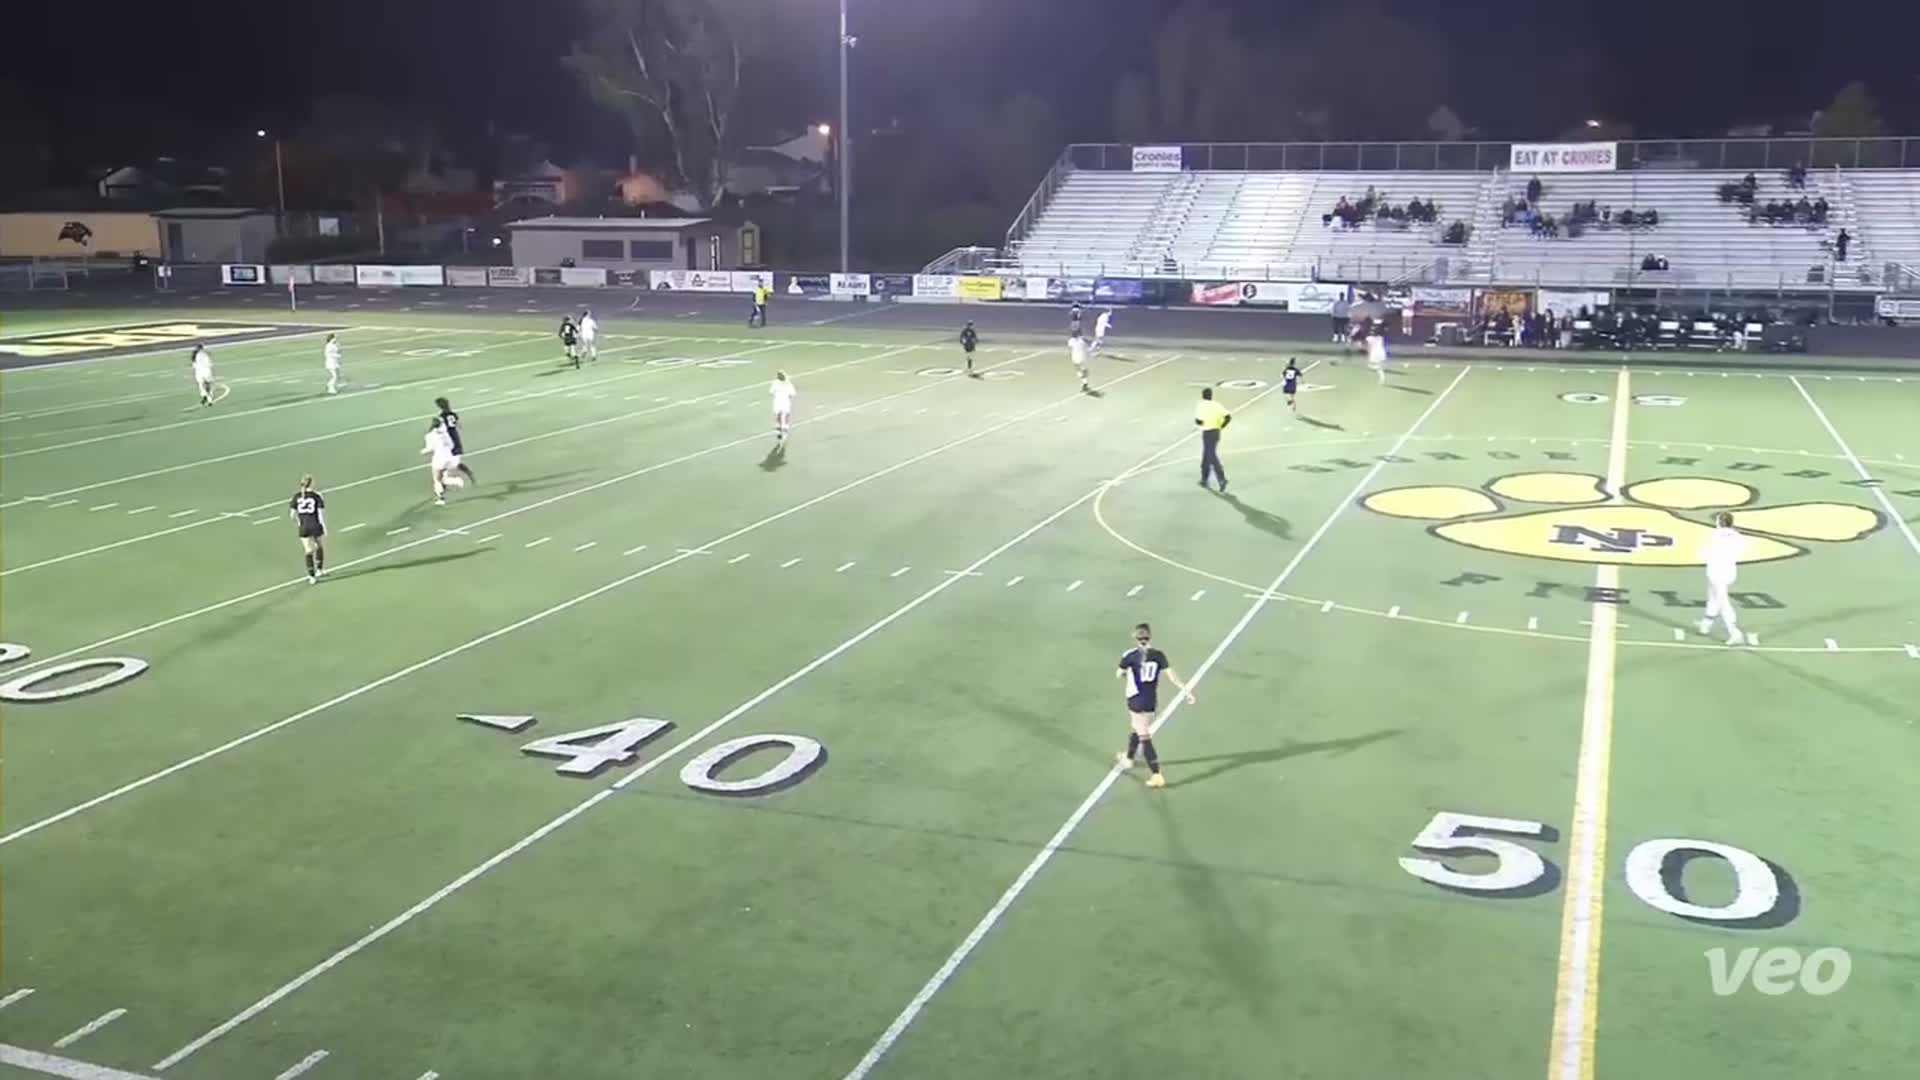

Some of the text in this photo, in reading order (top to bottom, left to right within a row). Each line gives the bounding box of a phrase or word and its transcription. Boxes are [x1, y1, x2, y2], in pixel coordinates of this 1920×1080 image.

[1134, 151, 1182, 161] Cronies
[1515, 149, 1613, 166] EAT AT CRONIES
[296, 496, 316, 514] 23
[1441, 571, 1786, 609] FIELD
[520, 716, 825, 792] 40
[1398, 811, 1781, 922] 50
